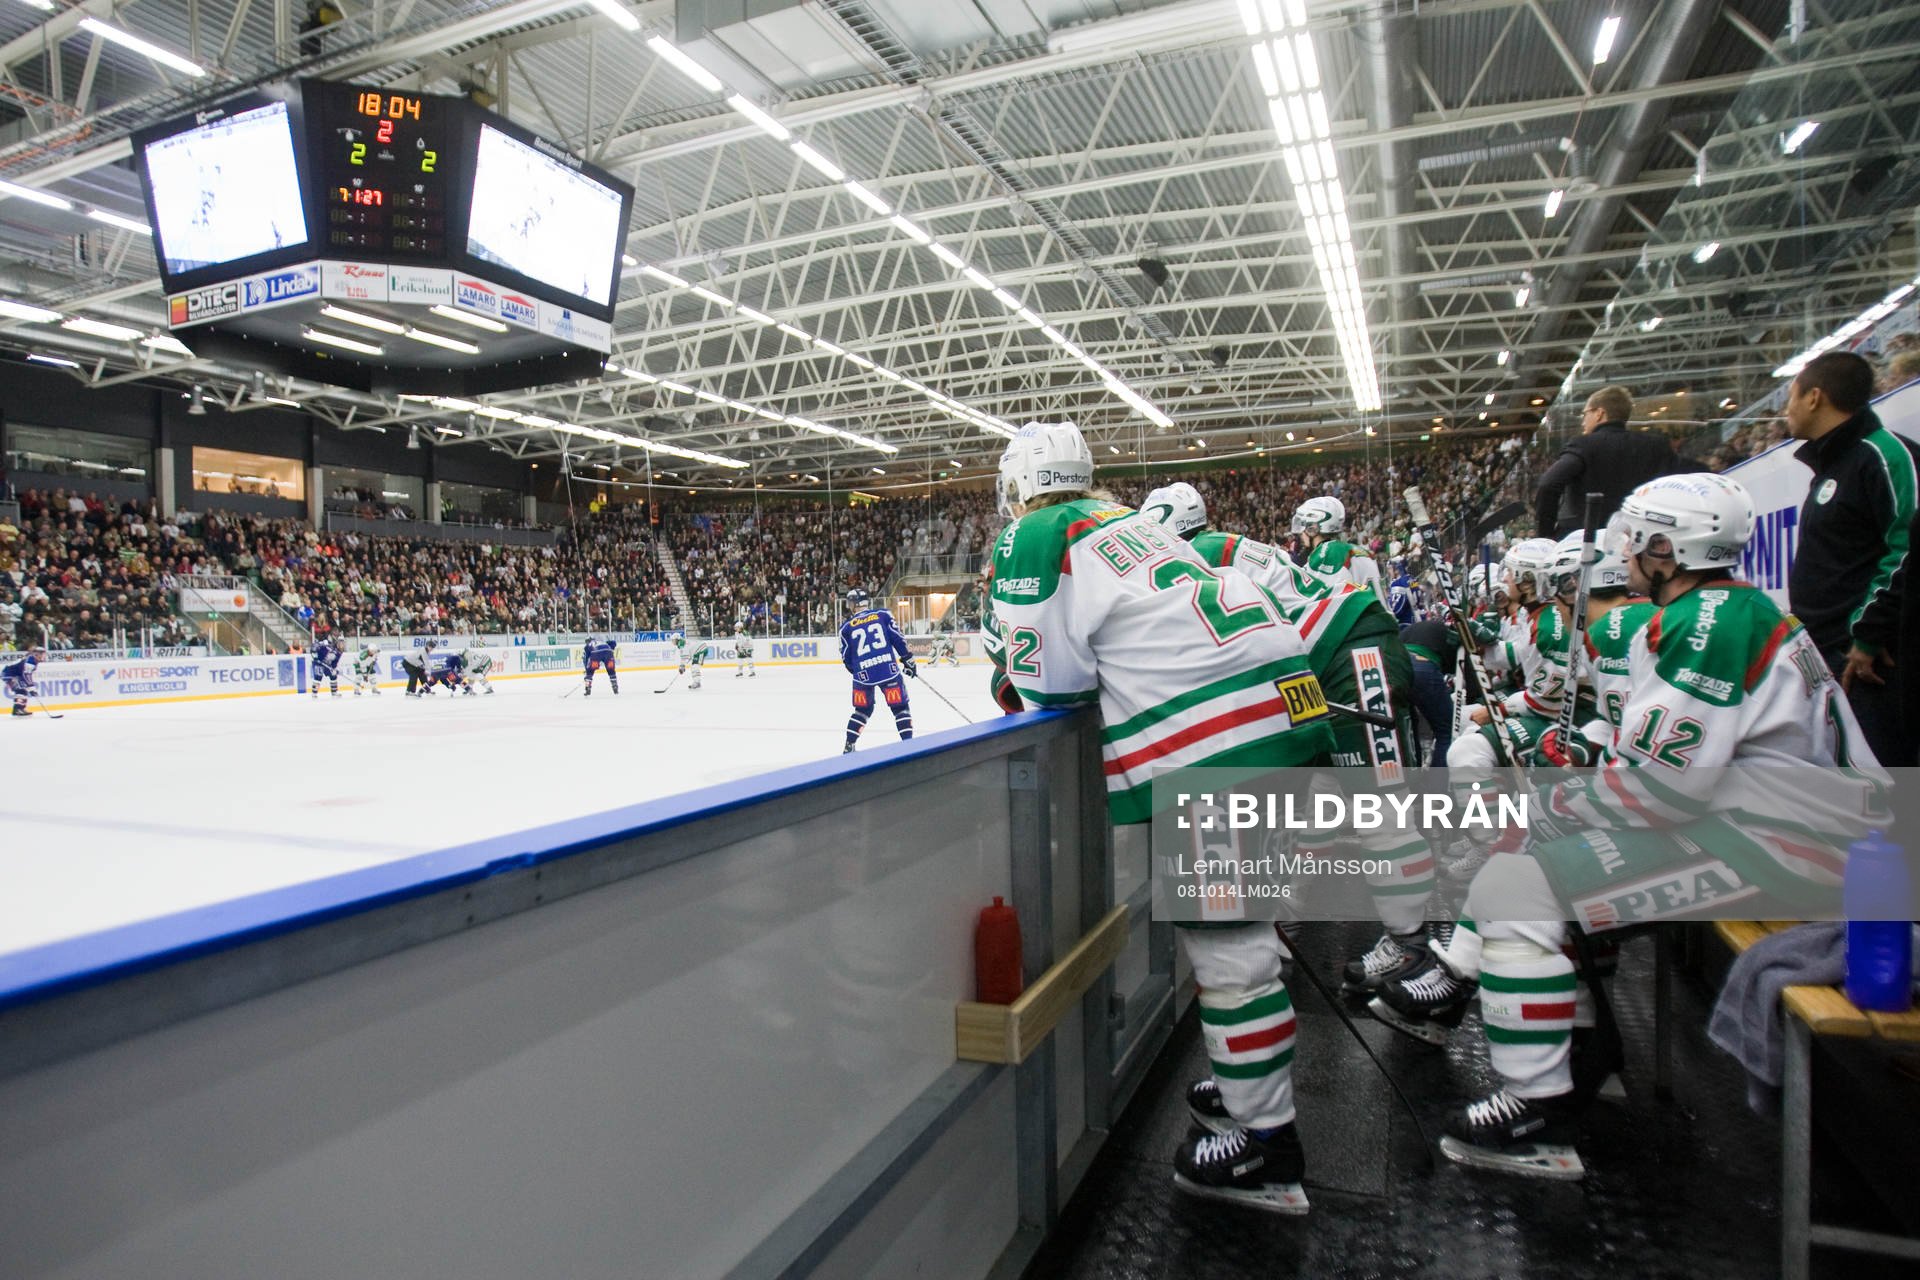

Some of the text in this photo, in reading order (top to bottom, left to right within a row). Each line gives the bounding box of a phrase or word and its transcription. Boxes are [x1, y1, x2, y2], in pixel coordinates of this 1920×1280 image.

[358, 92, 422, 121] 18:04
[376, 119, 394, 143] 2
[350, 142, 367, 166] 2
[421, 150, 438, 174] 2
[271, 272, 315, 298] Lindab
[458, 285, 496, 307] LAMARO
[501, 299, 536, 320] LAMARO
[851, 622, 887, 657] 23
[157, 646, 193, 658] RITTAL
[521, 649, 570, 672] Erikslund
[859, 653, 893, 670] PERSSON
[117, 664, 200, 680] INTERSPORT
[209, 667, 276, 683] TECODE
[1631, 704, 1706, 774] 12
[1608, 868, 1738, 922] PEA
